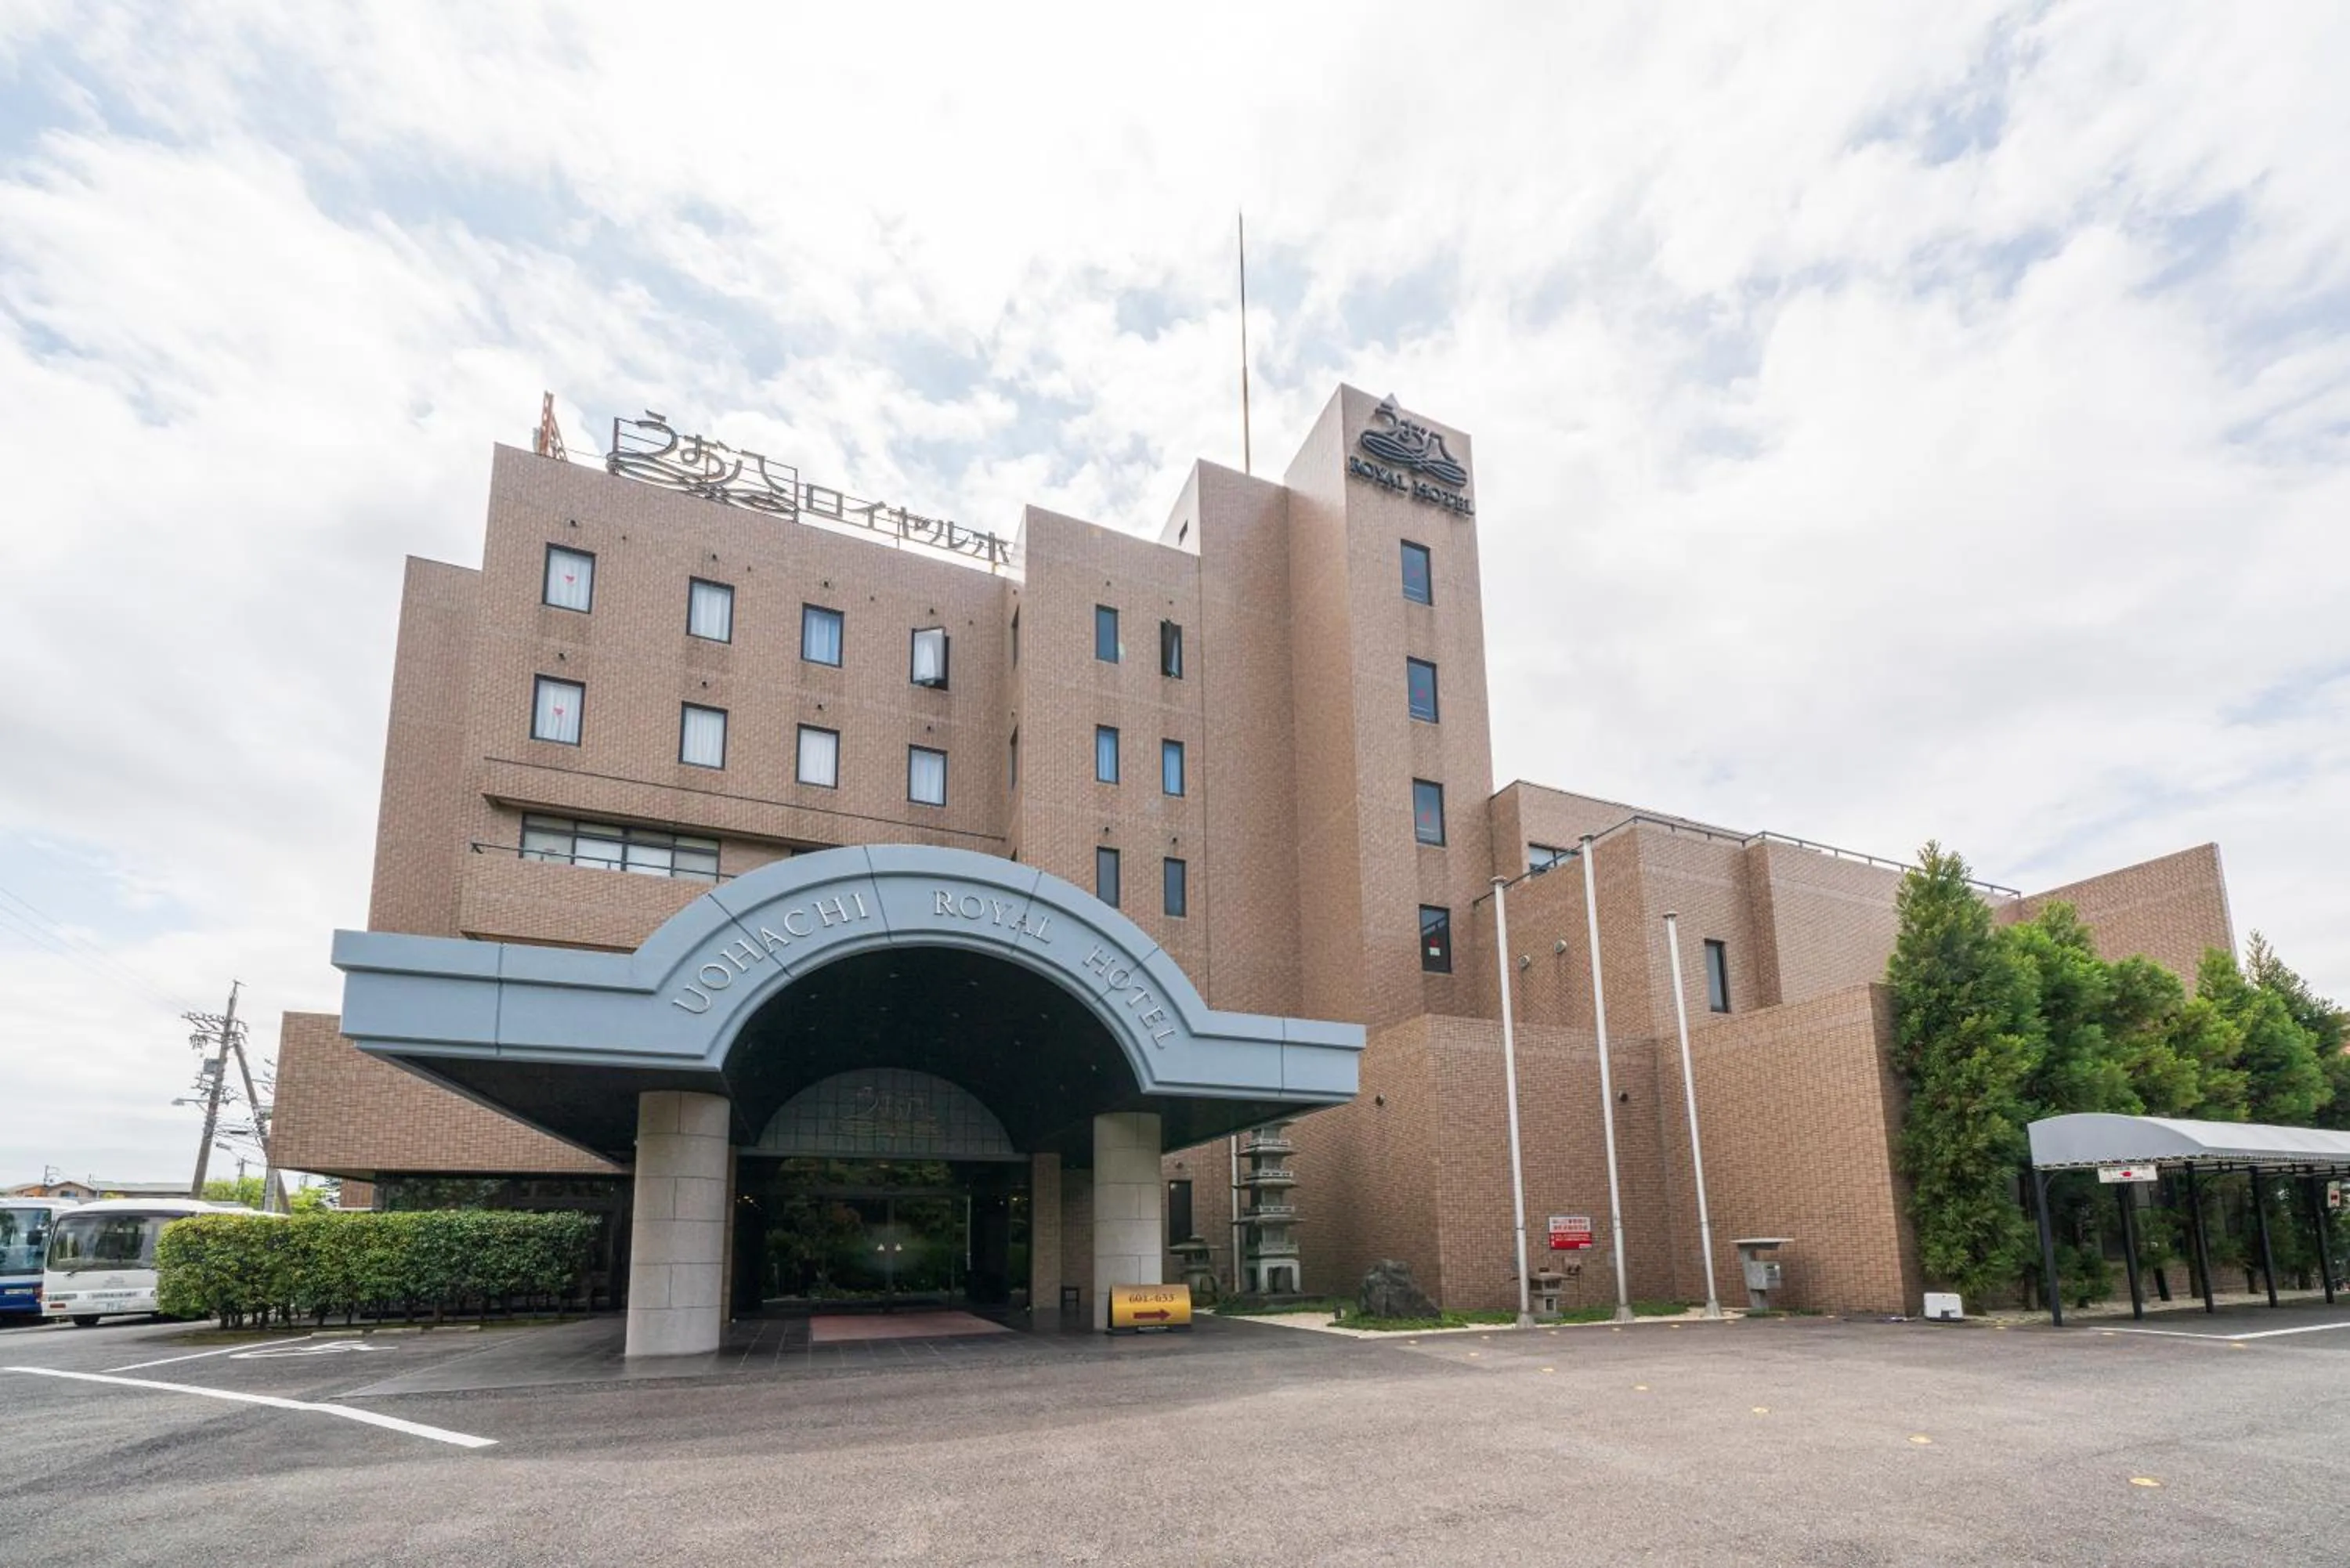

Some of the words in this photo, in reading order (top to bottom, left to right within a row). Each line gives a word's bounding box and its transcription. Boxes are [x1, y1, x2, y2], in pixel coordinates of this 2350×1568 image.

[1349, 456, 1408, 492] ROYAL
[1412, 479, 1474, 515] HOTEL
[672, 892, 870, 1014] UOHACHI
[933, 890, 1051, 945] ROYAL
[1082, 945, 1176, 1050] HOTEL
